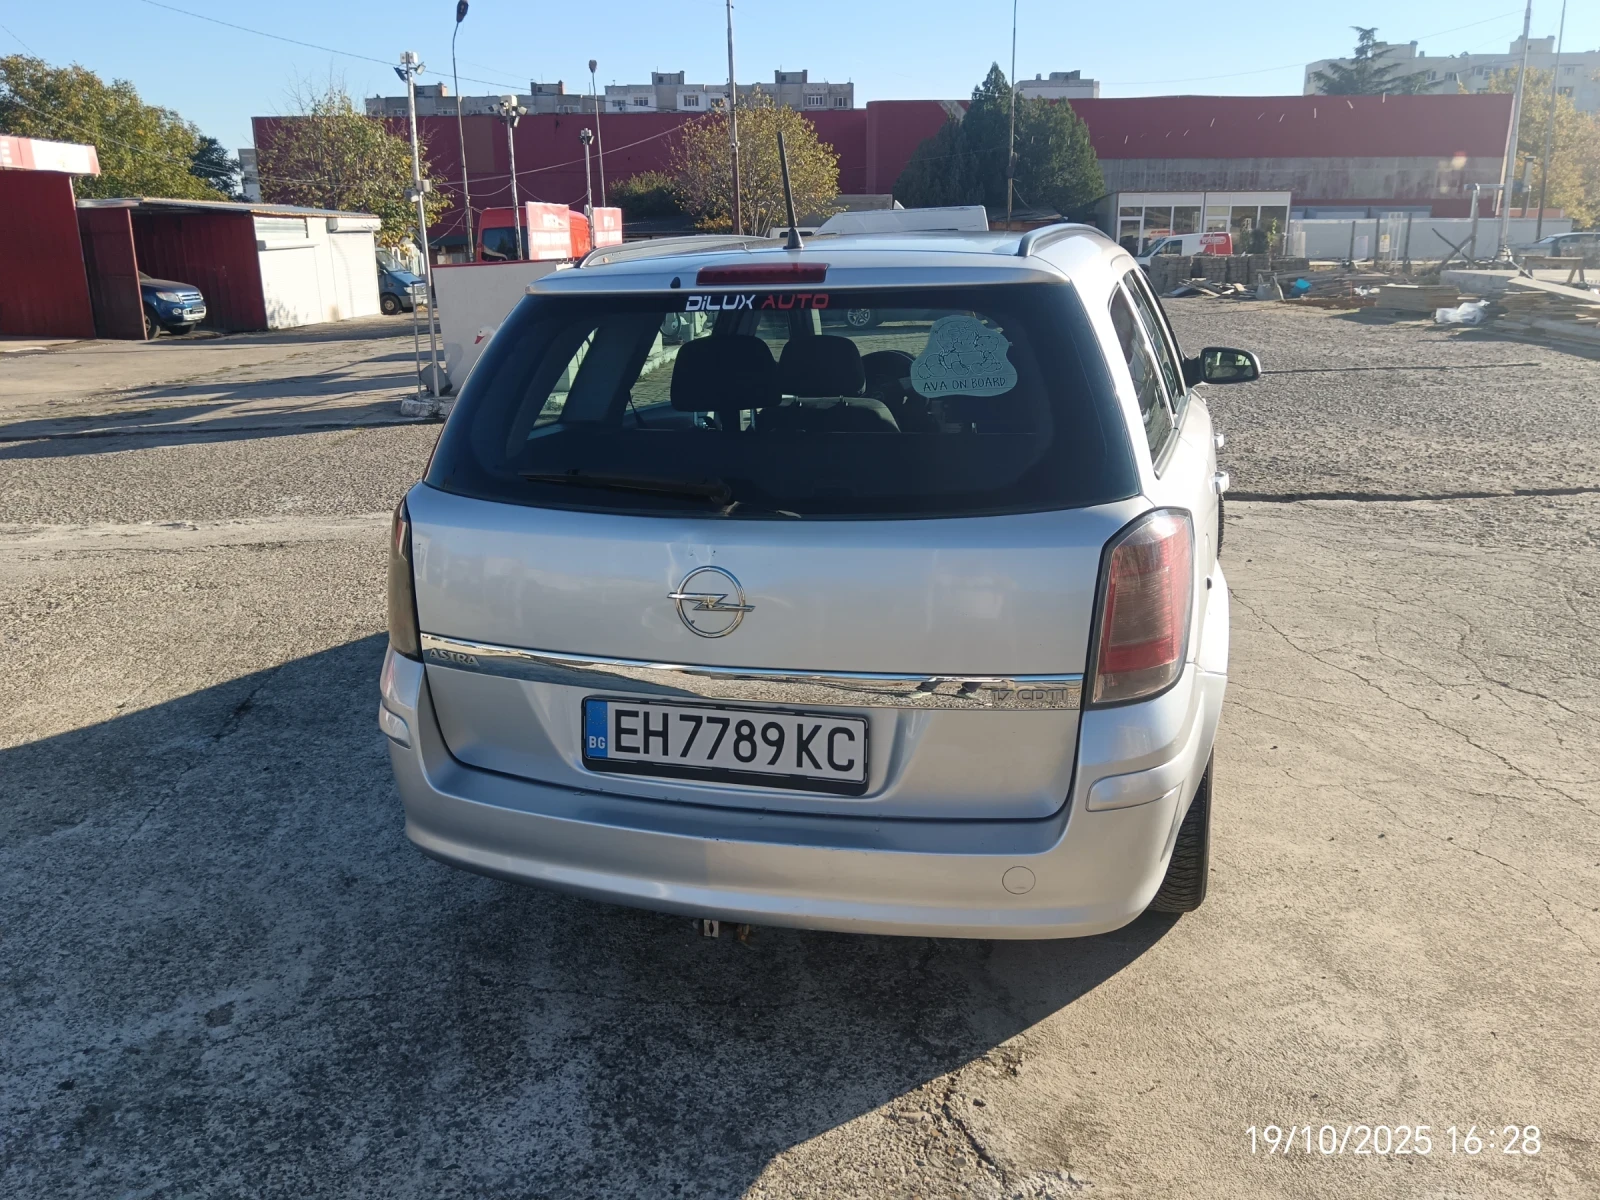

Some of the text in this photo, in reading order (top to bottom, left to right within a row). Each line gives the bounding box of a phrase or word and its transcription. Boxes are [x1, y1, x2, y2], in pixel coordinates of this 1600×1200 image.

[761, 293, 830, 309] AUTO
[923, 377, 1006, 392] AVA ON BOARD
[430, 648, 480, 667] ASTRA
[1017, 688, 1068, 703] CDTI
[588, 735, 606, 749] BG
